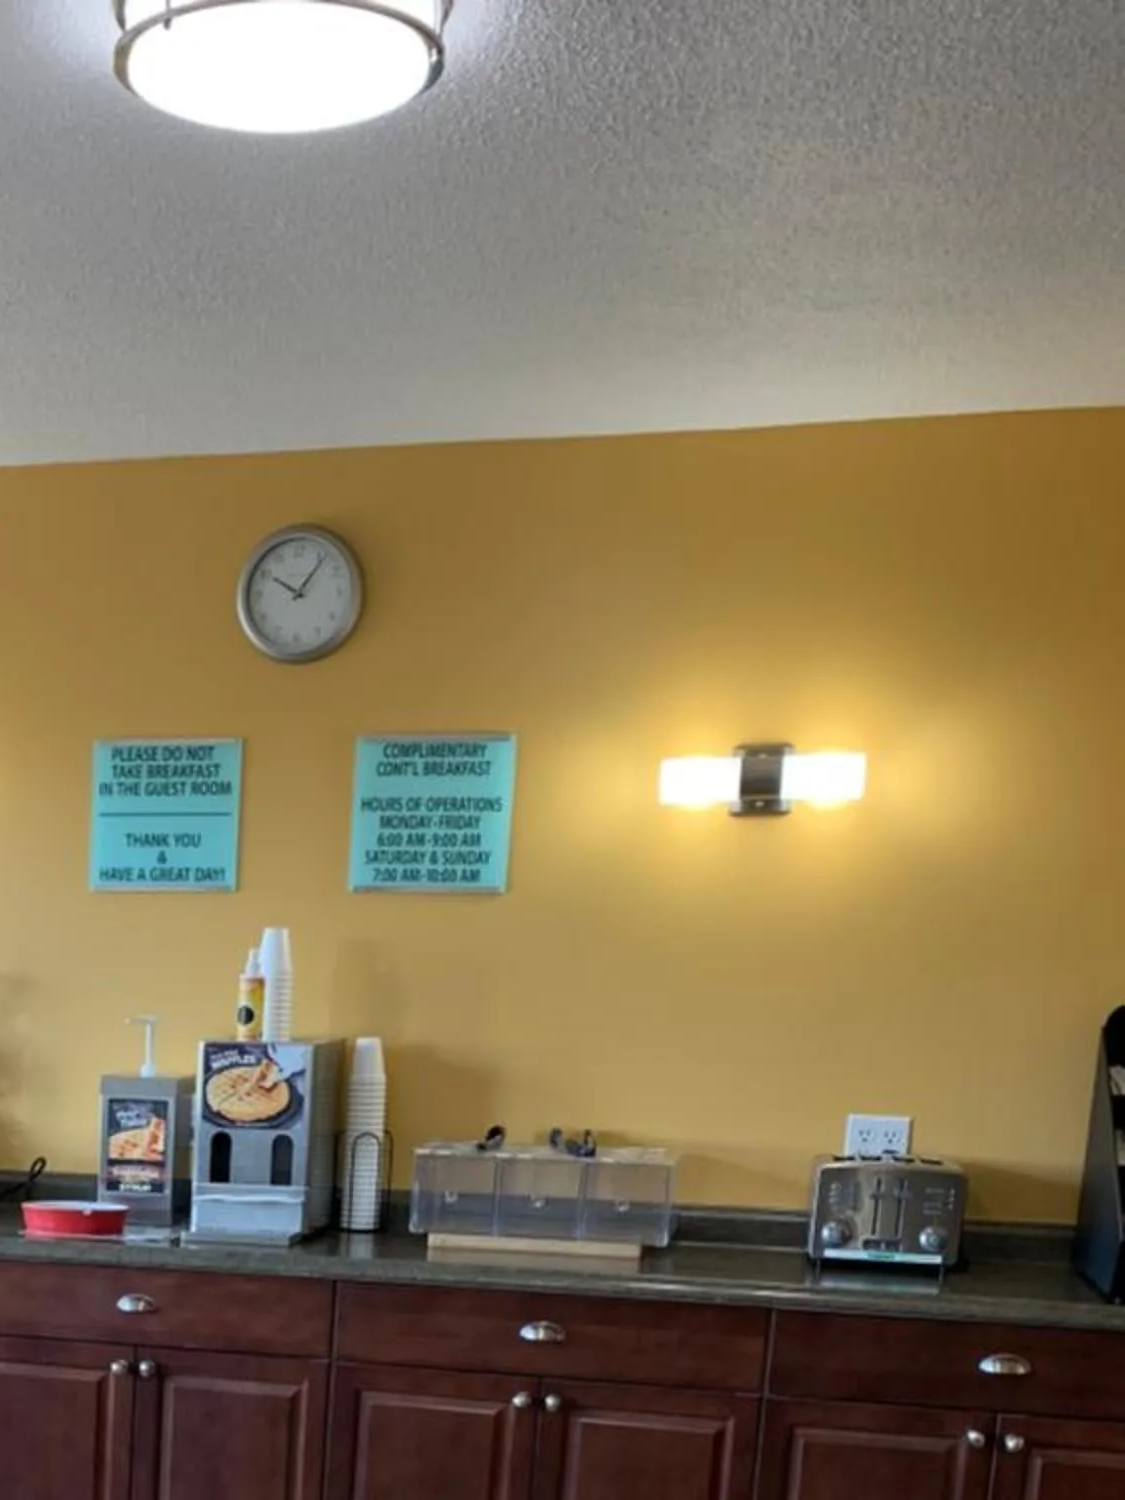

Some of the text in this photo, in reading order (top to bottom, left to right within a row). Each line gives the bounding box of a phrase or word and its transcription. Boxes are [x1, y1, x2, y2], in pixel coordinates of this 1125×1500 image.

[112, 746, 215, 761] PLEASE DO NOT
[383, 743, 487, 758] COMPLIMENTARY
[112, 764, 221, 778] TAKE BREAKFAST
[423, 761, 491, 776] BREAKFAST
[99, 781, 232, 796] IN THE GUEST ROOM
[361, 797, 502, 812] HOURS OF OPERATIONS
[125, 833, 202, 848] THANK YOU
[460, 832, 481, 846] AM
[365, 850, 426, 865] SATURDAY
[442, 850, 491, 865] SUNDAY
[99, 868, 134, 881] HAVE
[136, 868, 147, 881] A
[149, 867, 191, 882] GREAT
[459, 868, 481, 882] AM
